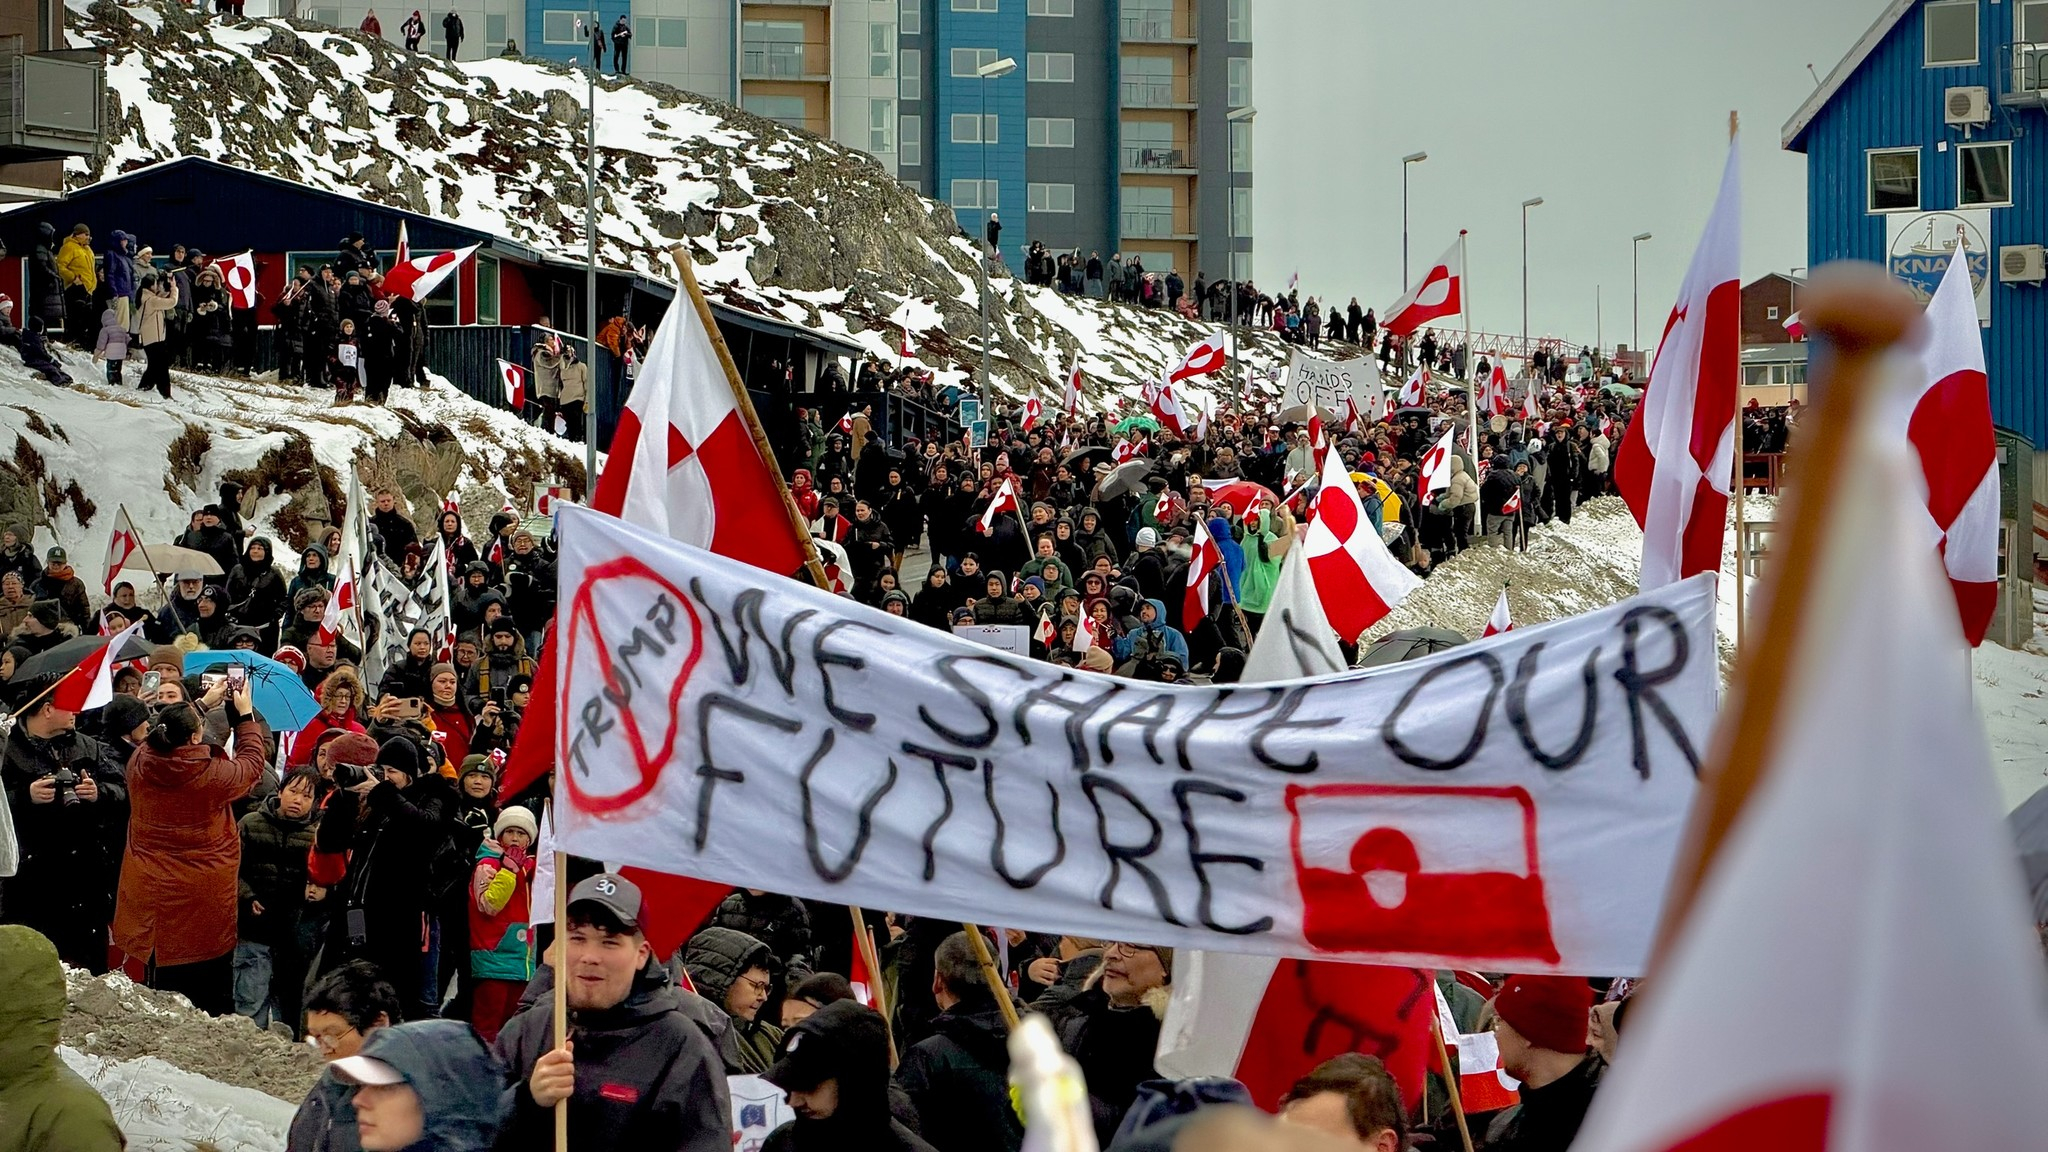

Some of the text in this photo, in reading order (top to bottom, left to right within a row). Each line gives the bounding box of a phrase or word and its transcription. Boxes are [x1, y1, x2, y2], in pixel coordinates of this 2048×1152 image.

[1893, 255, 1986, 275] KNAK
[1299, 363, 1352, 390] HANDS
[1297, 381, 1346, 407] OFF
[568, 593, 677, 778] TRUMP
[690, 575, 894, 732] WE
[919, 654, 1370, 774] SHAPE
[1381, 605, 1704, 781] OUR
[696, 691, 1274, 935] FUTURE
[595, 879, 616, 896] 30
